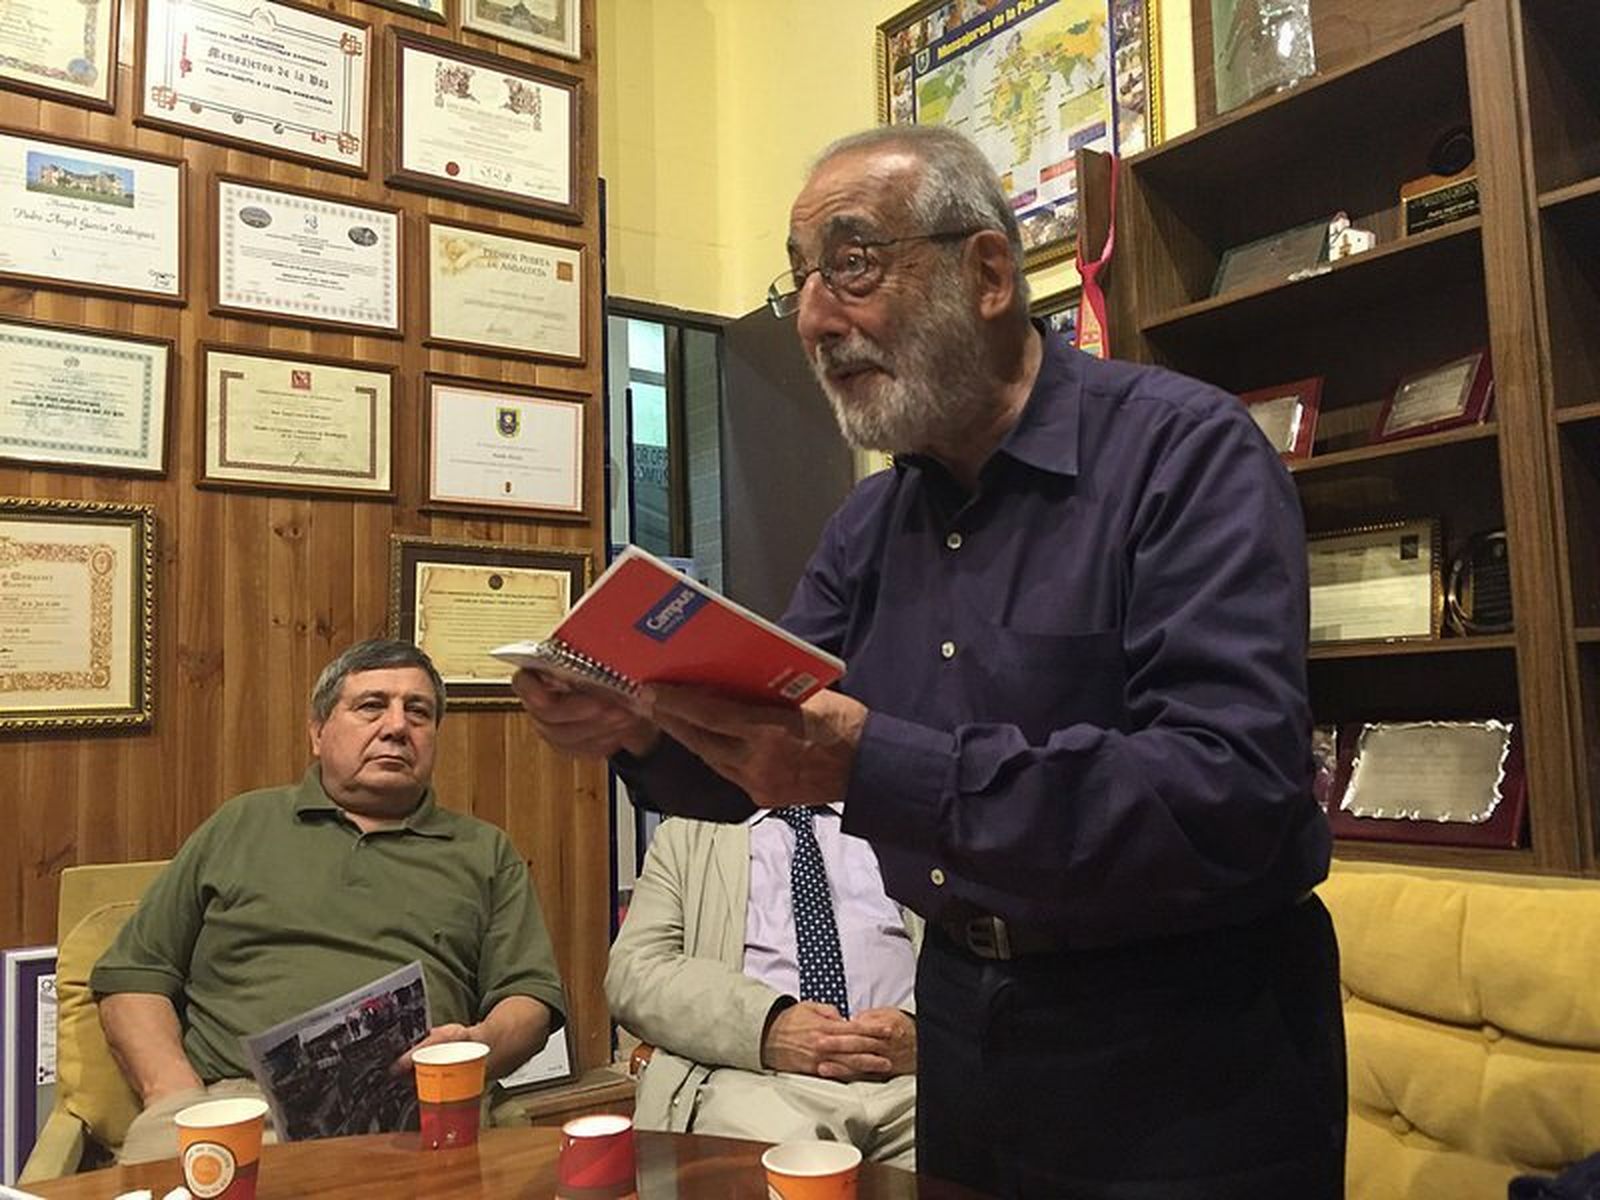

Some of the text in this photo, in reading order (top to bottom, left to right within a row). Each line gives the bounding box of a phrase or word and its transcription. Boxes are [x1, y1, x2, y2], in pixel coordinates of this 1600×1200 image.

[937, 21, 991, 59] Mensajeros
[992, 14, 1005, 29] de
[646, 588, 696, 630] Campus
